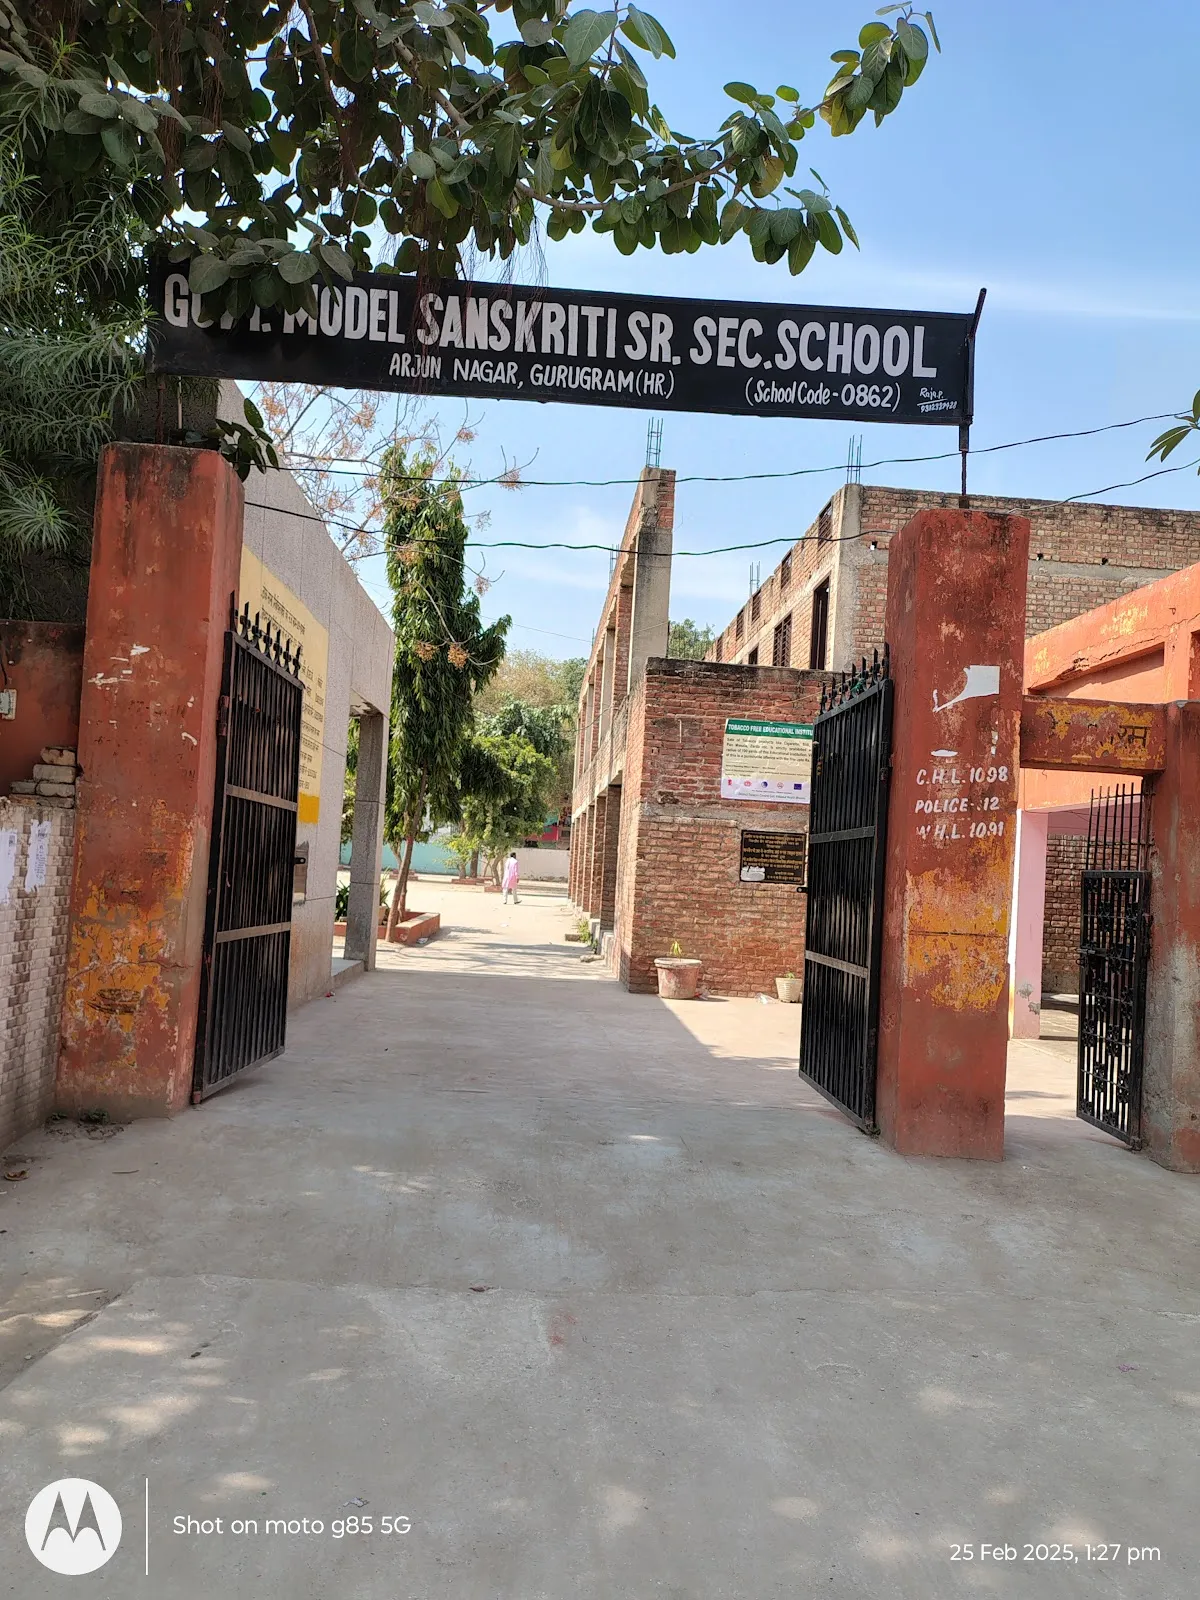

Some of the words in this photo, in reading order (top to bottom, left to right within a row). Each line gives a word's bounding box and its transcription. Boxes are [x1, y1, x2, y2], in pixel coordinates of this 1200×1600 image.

[416, 292, 618, 359] SANSKRITI
[624, 310, 682, 366] SR.
[388, 352, 442, 380] ARJUN
[453, 358, 524, 389] NAGAR,
[916, 768, 966, 785] C.H.L.
[969, 765, 1009, 783] 1098
